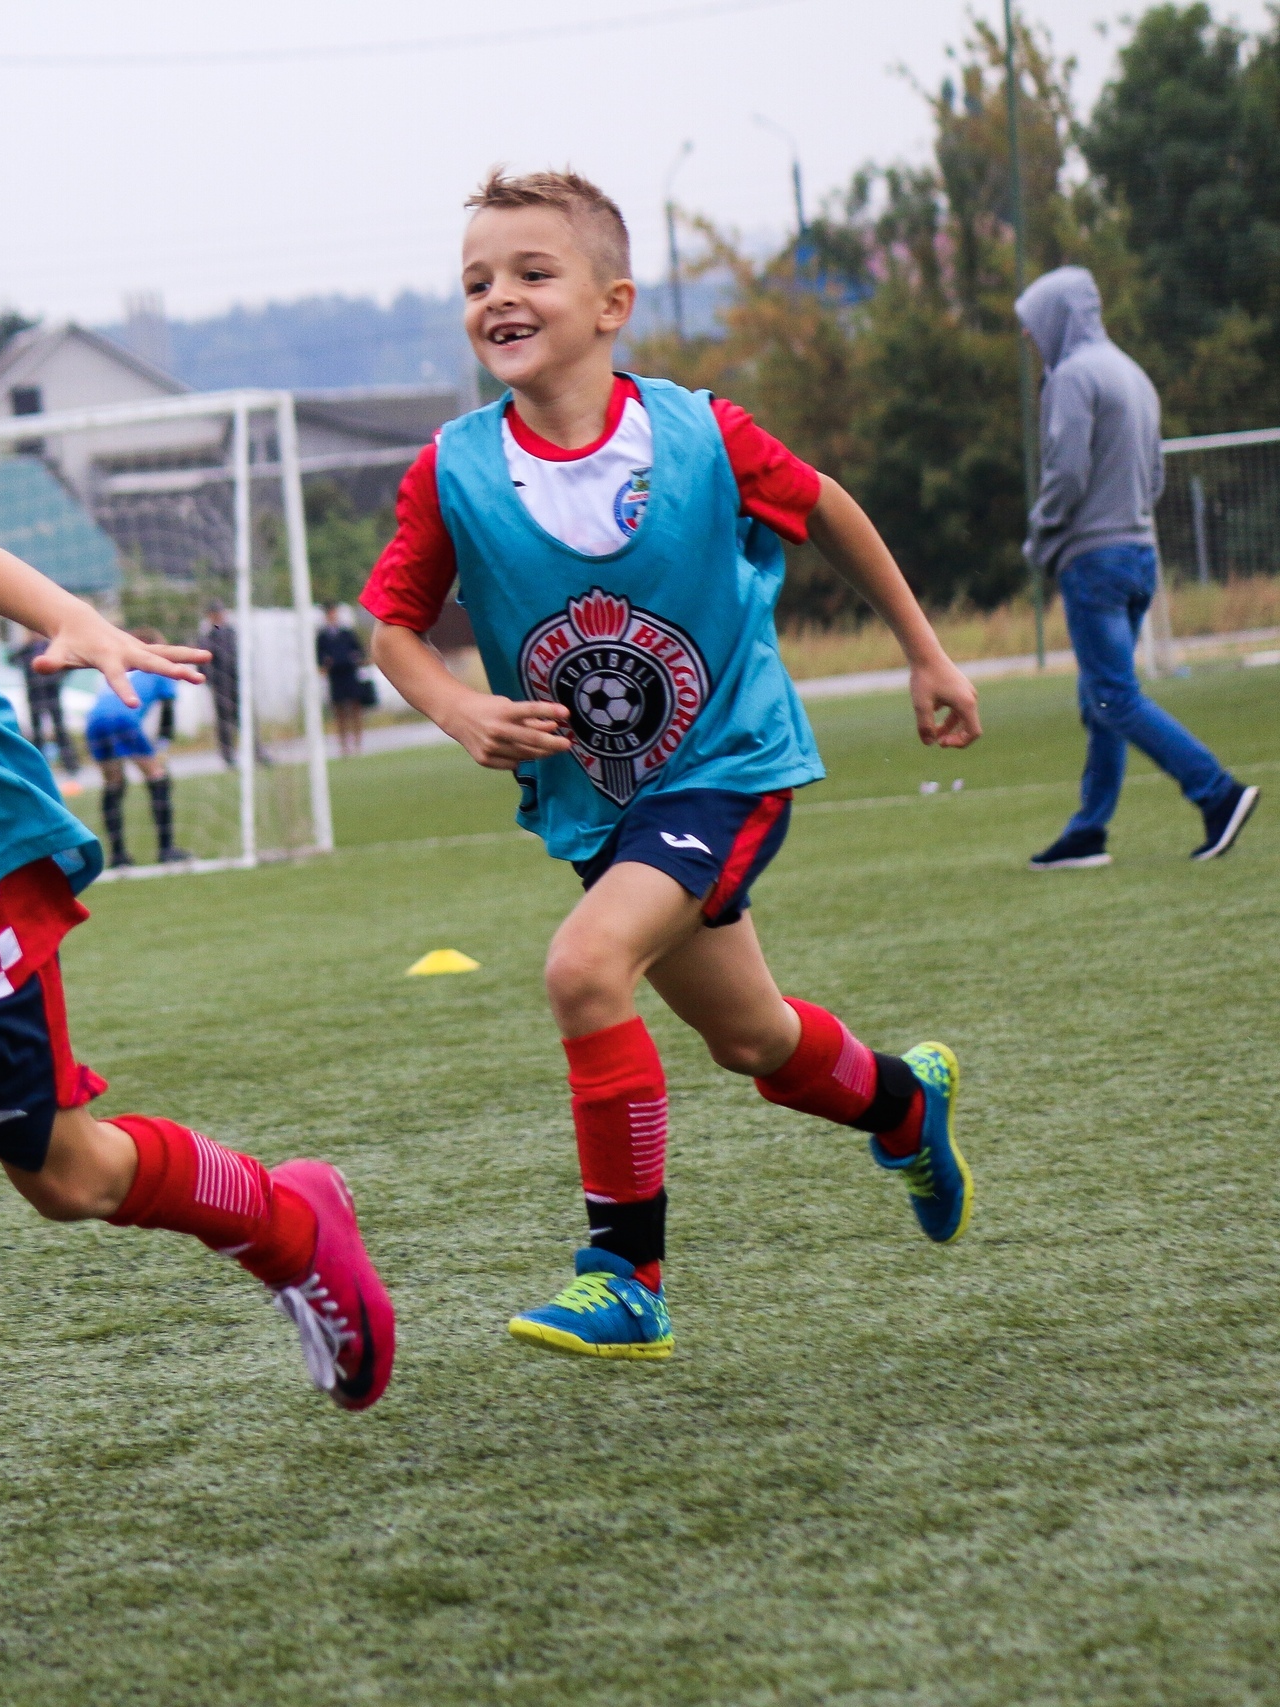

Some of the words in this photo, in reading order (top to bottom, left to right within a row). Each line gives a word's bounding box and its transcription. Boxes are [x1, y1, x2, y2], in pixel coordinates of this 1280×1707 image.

[560, 652, 657, 689] FOOTBALL
[630, 624, 698, 769] BELGOROD
[590, 732, 641, 751] CLUB
